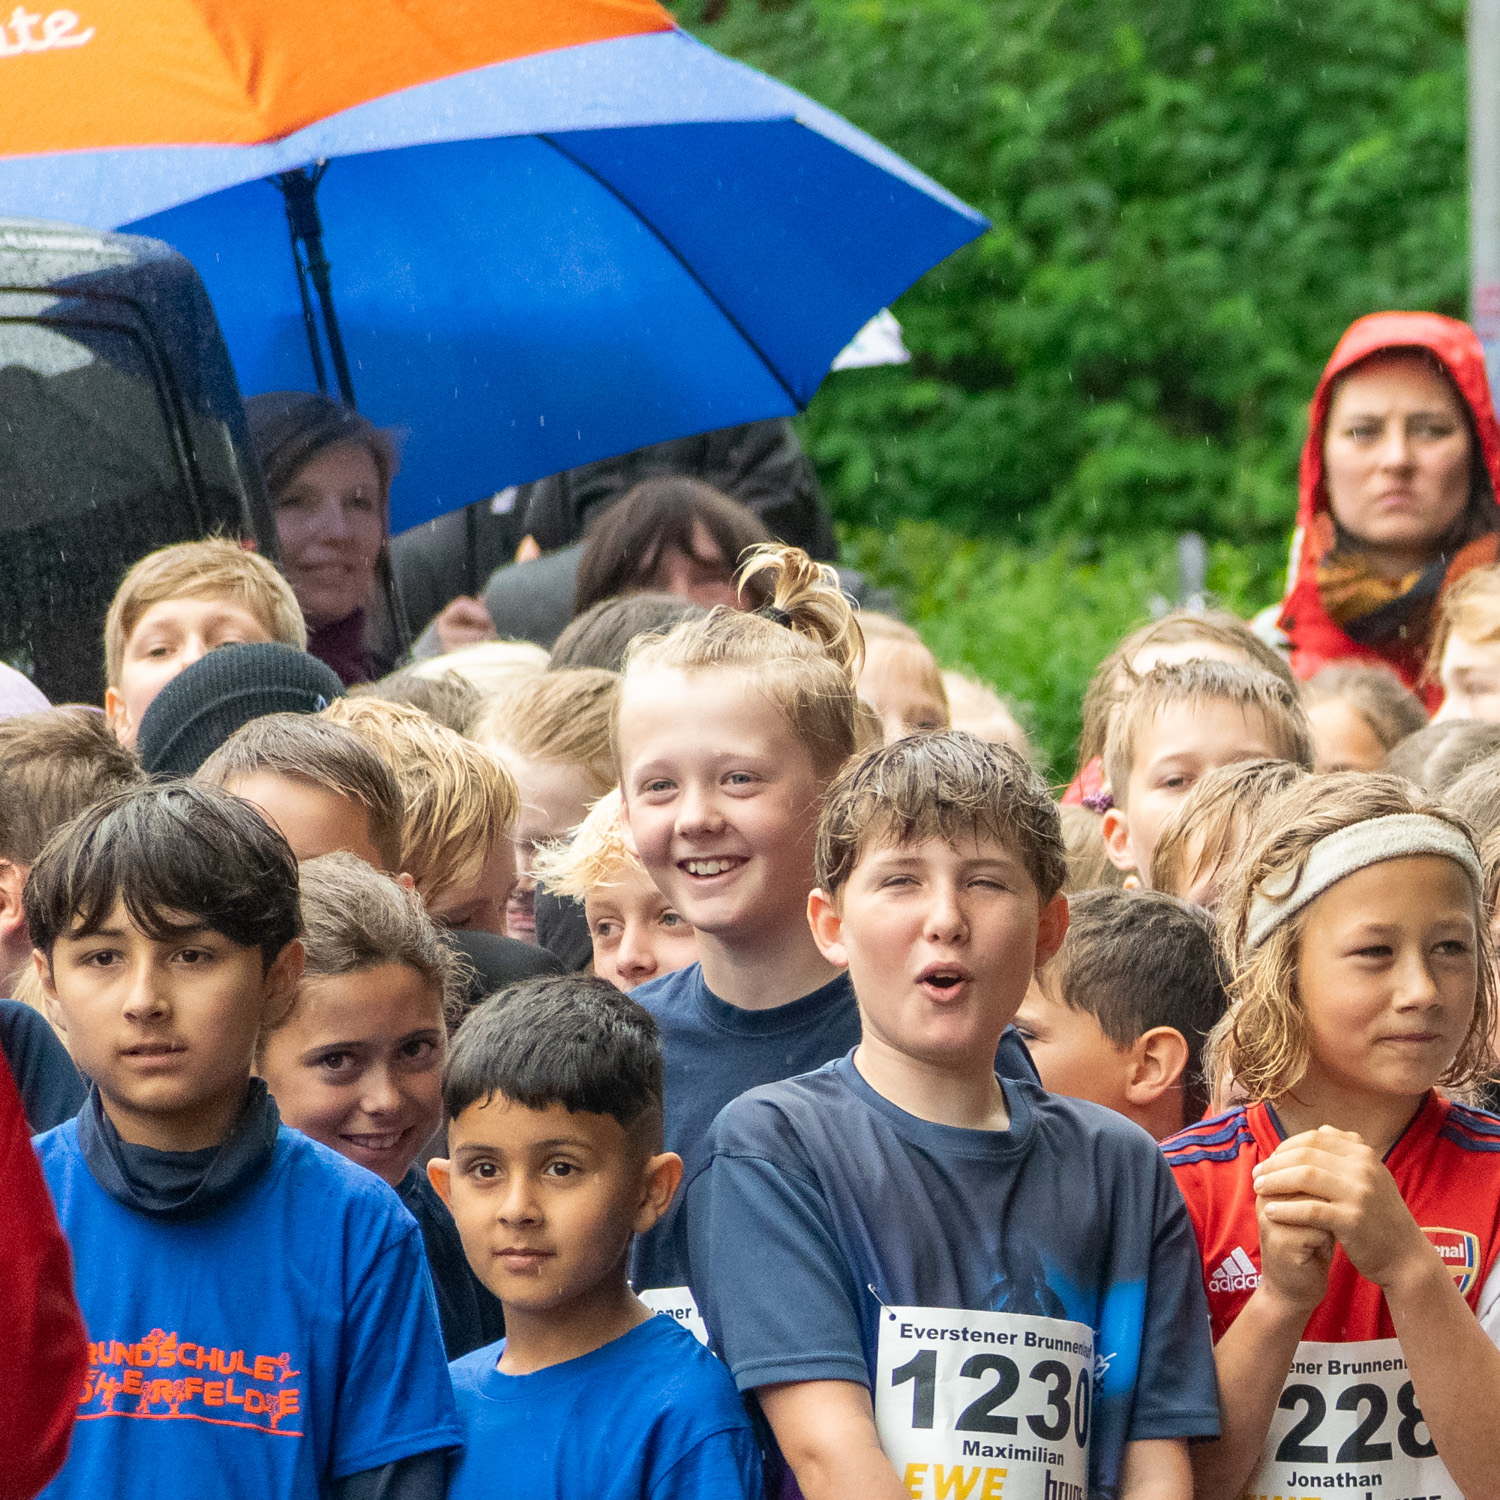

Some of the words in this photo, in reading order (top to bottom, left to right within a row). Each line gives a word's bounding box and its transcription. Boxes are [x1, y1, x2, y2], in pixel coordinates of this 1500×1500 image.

[900, 1323, 1018, 1345] Everstener
[87, 1341, 277, 1381] RUNDSCHULE
[1327, 1358, 1408, 1376] Brunnen
[891, 1349, 1090, 1449] 1230
[1275, 1380, 1439, 1463] 228
[962, 1440, 1064, 1466] Maximilian
[1287, 1471, 1382, 1488] Jonathan
